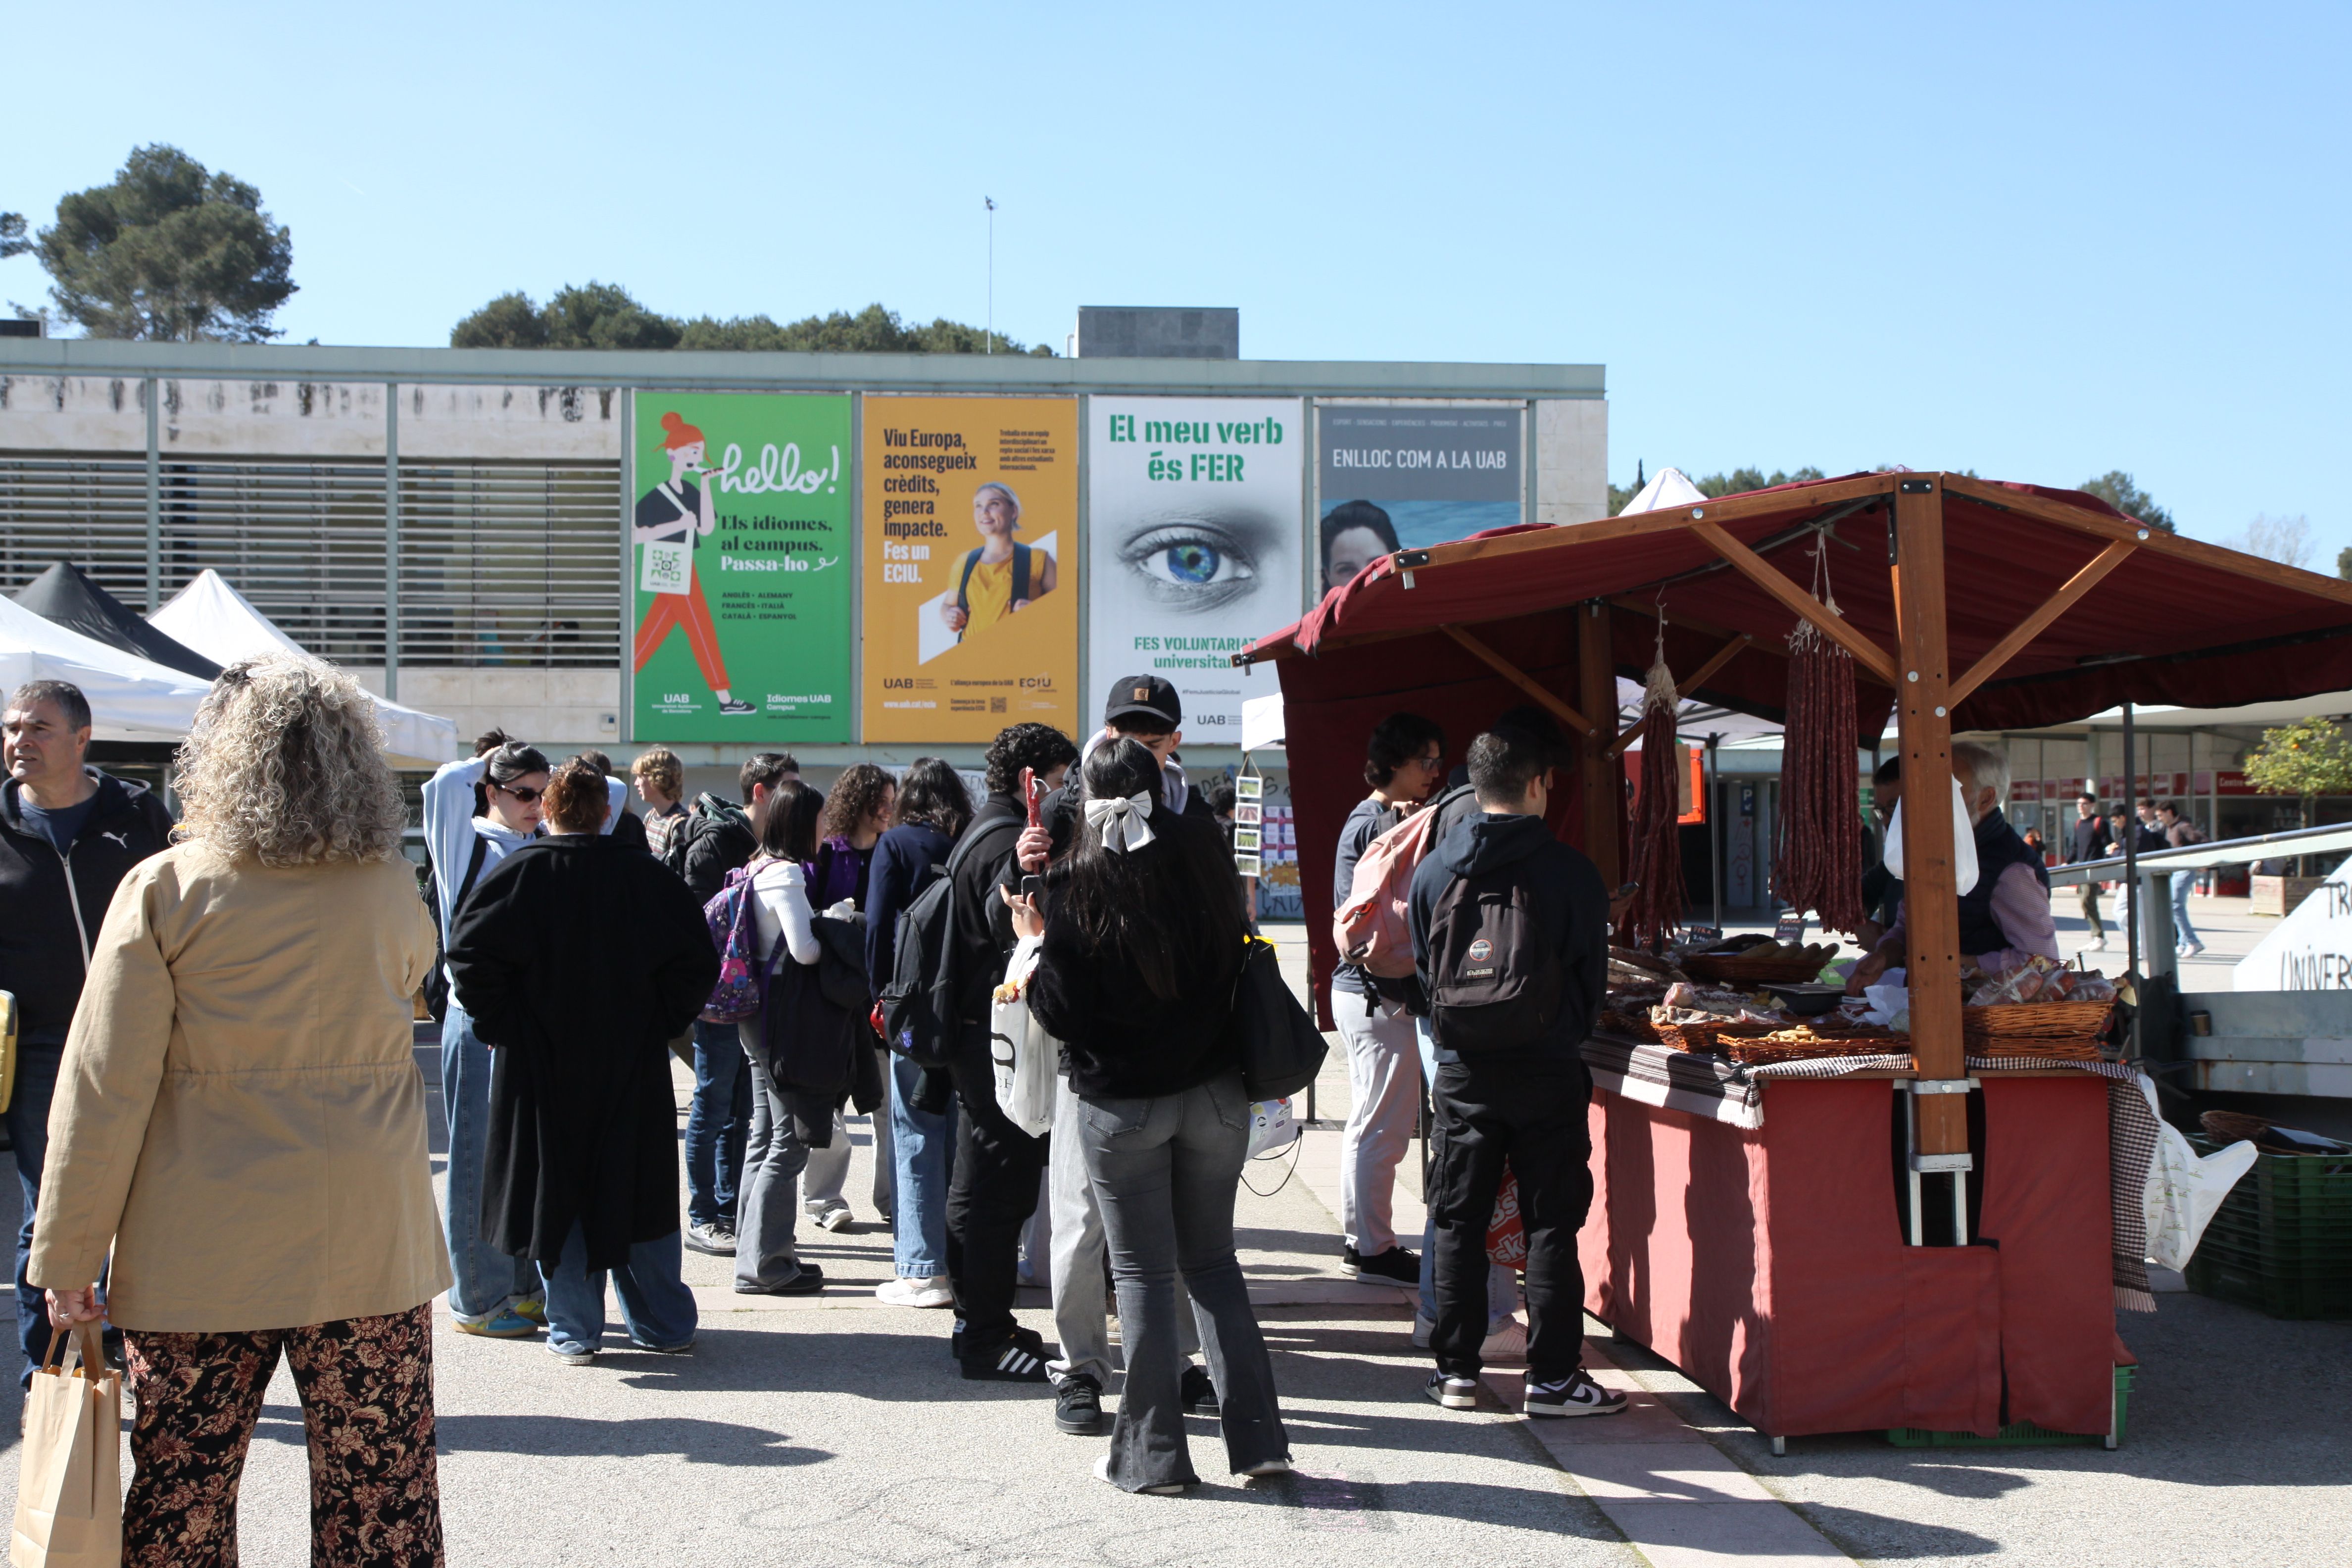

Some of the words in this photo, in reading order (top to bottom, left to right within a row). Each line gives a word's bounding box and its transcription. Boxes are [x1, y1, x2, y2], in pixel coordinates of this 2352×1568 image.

[1110, 414, 1136, 442] El
[1145, 421, 1209, 443] meu
[1217, 417, 1282, 444] verb
[884, 429, 907, 446] Viu
[911, 429, 966, 450] Europa,
[721, 443, 840, 494] hello!
[884, 452, 977, 473] aconsegueix
[1148, 450, 1182, 481] és
[1191, 454, 1244, 482] FER
[1333, 449, 1391, 468] ENLLOC
[1397, 449, 1431, 468] COM
[1436, 450, 1447, 468] A
[1452, 450, 1471, 469] LA
[1476, 451, 1507, 469] UAB
[884, 474, 939, 496] crèdits,
[884, 500, 934, 518] genera
[722, 515, 748, 531] Els
[753, 515, 833, 532] idiomes,
[884, 518, 947, 540] impacte.
[721, 536, 738, 551] al
[743, 538, 823, 555] campus.
[884, 541, 909, 560] Fes
[912, 545, 930, 560] un
[721, 555, 808, 572] Passa-ho
[884, 564, 922, 583] ECIU.
[1134, 637, 1160, 650] FES
[884, 678, 913, 689] UAB
[1020, 678, 1051, 687] ECIU
[664, 693, 689, 703] UAB
[767, 694, 808, 703] Idiomes
[809, 694, 832, 703] UAB
[1197, 715, 1225, 725] UAB
[1744, 789, 1752, 801] P
